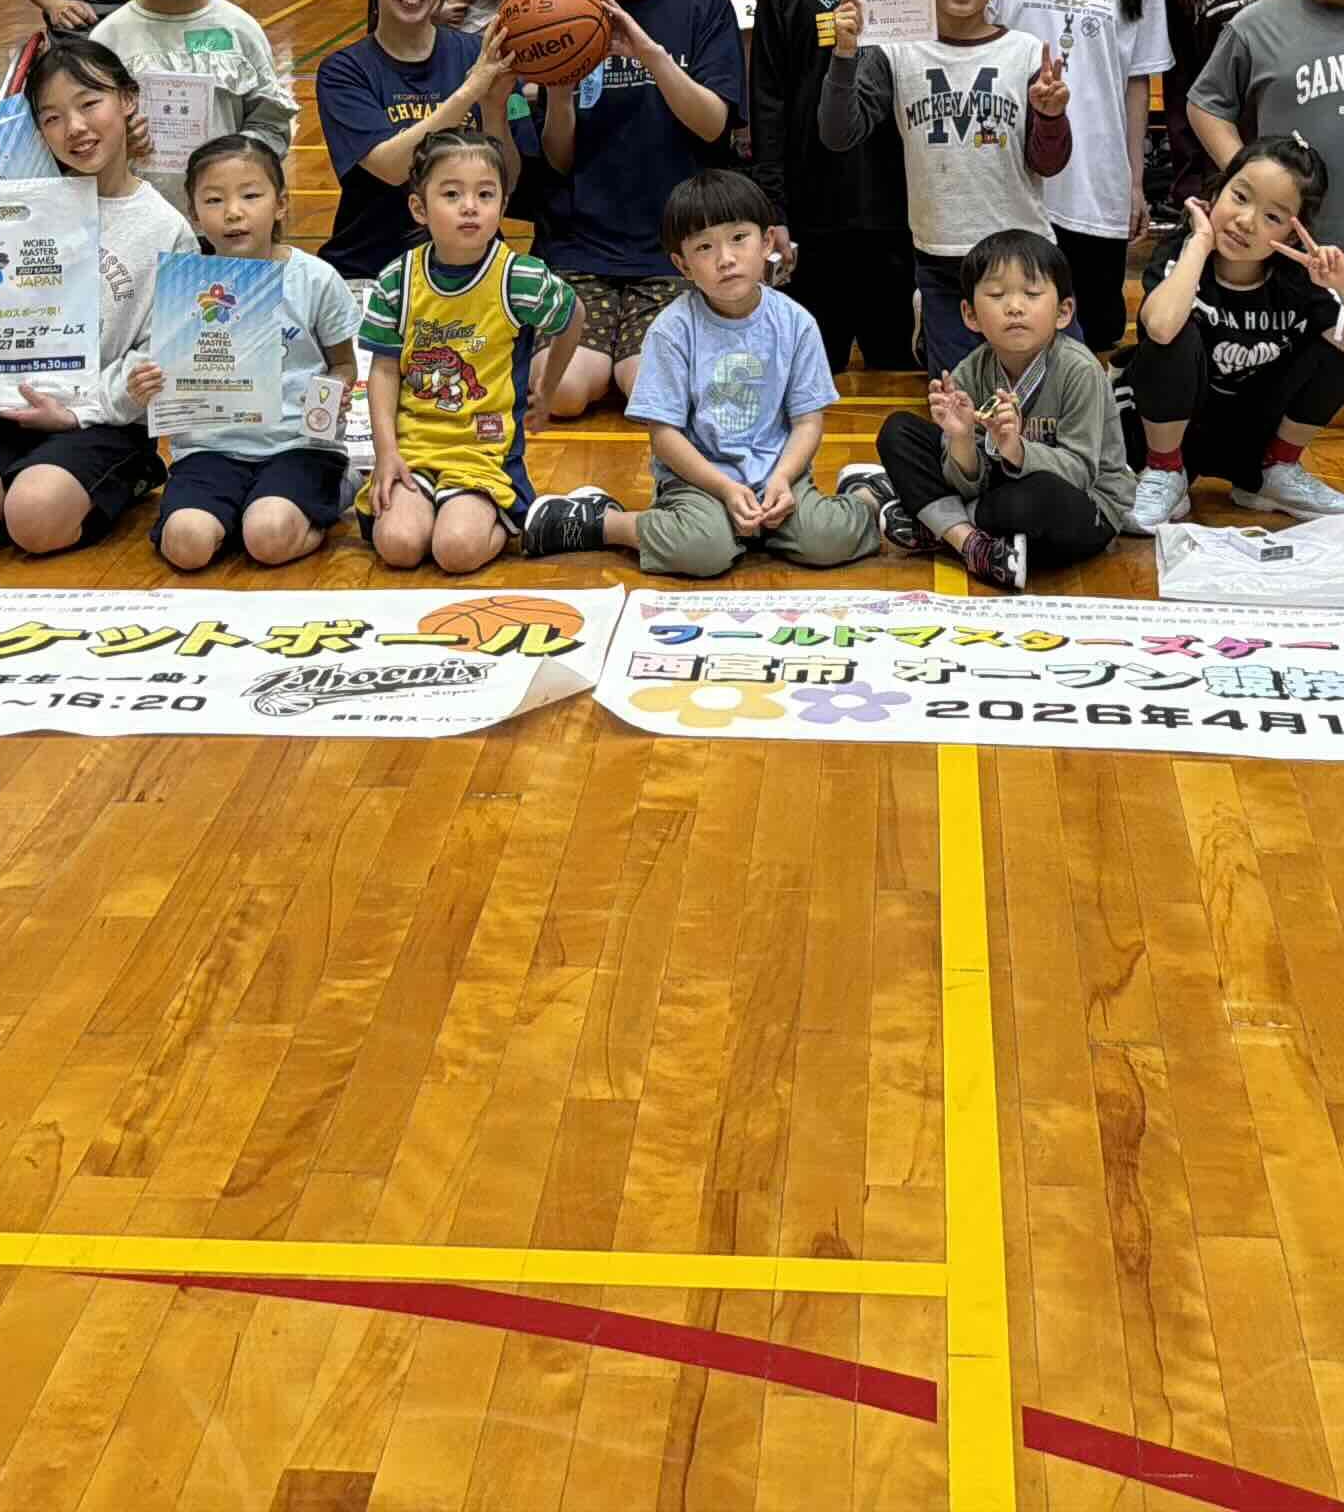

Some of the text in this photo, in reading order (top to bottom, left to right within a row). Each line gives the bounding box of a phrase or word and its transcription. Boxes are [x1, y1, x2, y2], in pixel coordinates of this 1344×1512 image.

[905, 90, 1019, 130] MICKEY MOUSE
[22, 239, 56, 247] WORLD
[19, 248, 59, 256] MASTERS
[22, 257, 56, 265] GAMES
[16, 275, 63, 288] JAPAN
[627, 651, 858, 684] 西宮市
[241, 658, 496, 696] Phoenix
